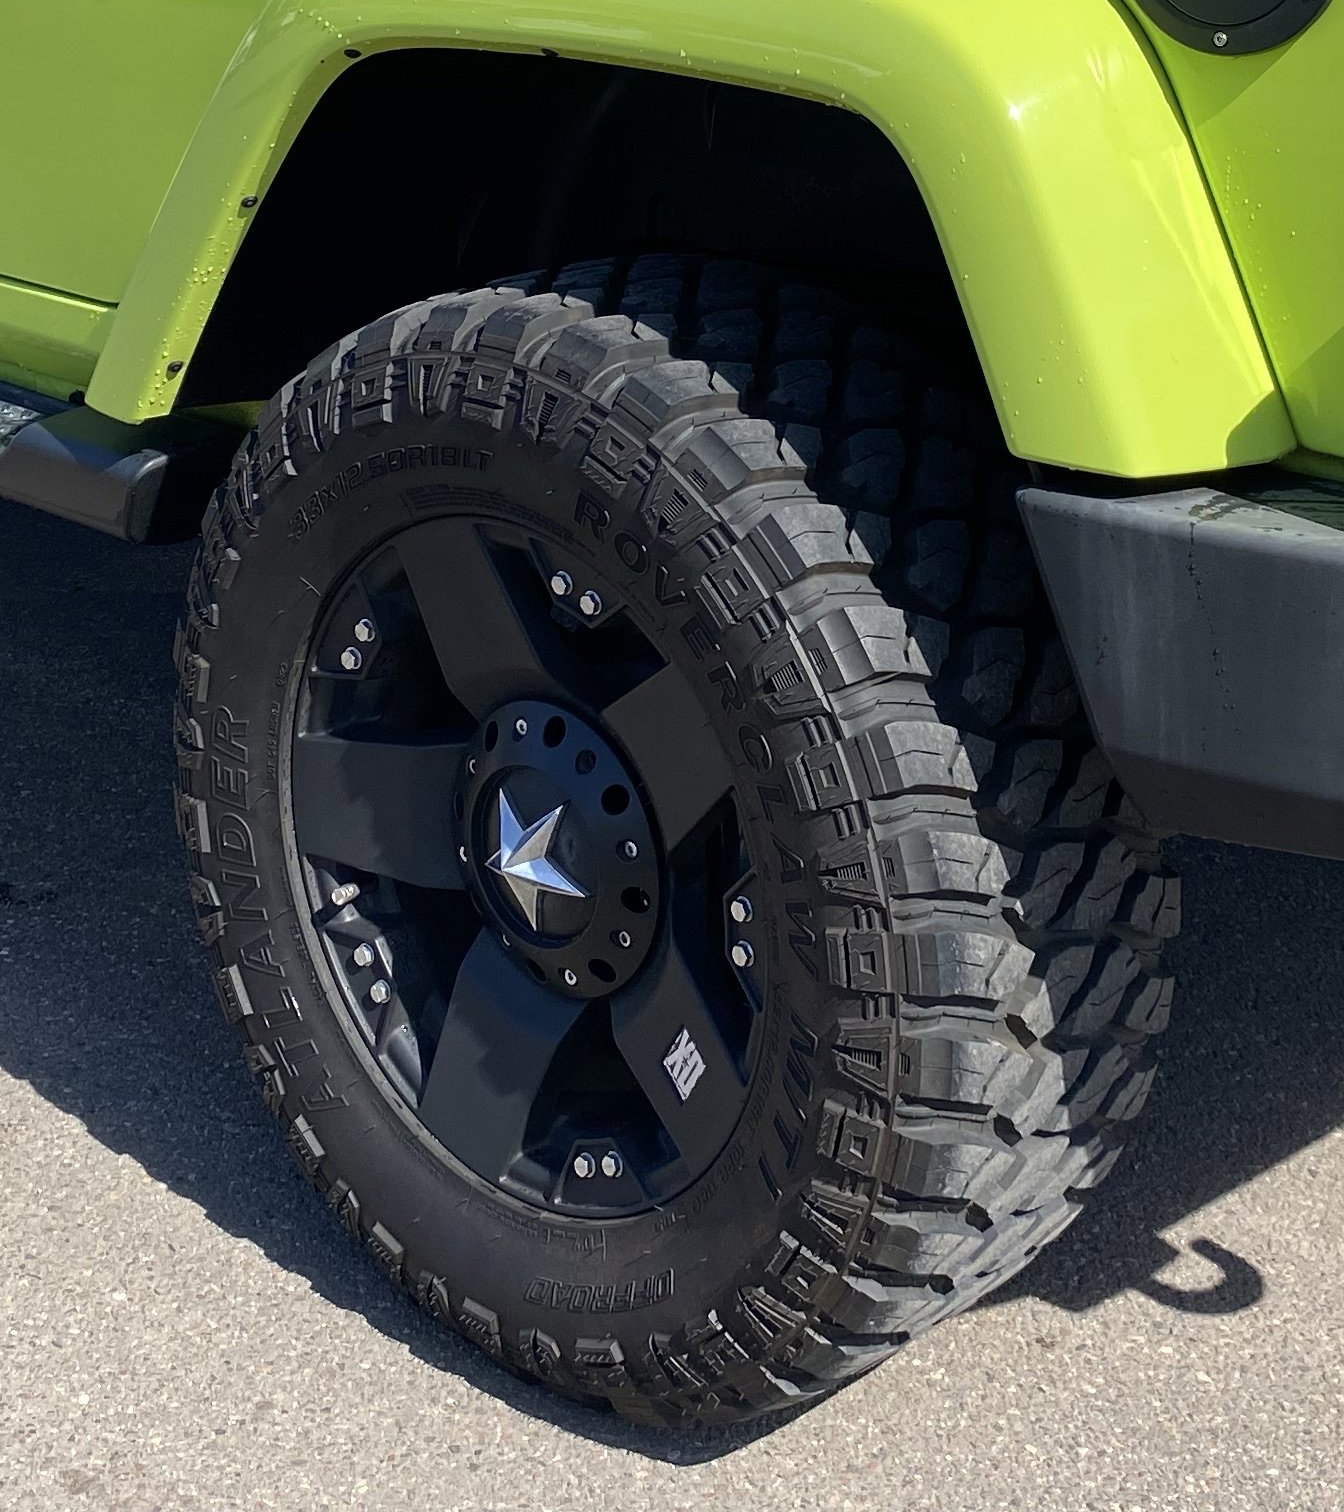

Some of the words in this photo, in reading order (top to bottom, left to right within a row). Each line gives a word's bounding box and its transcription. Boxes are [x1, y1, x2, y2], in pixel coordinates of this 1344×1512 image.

[209, 703, 350, 1113] ATLANDER
[575, 493, 819, 981] ROVERCLAW
[522, 1266, 676, 1315] OFFROAD
